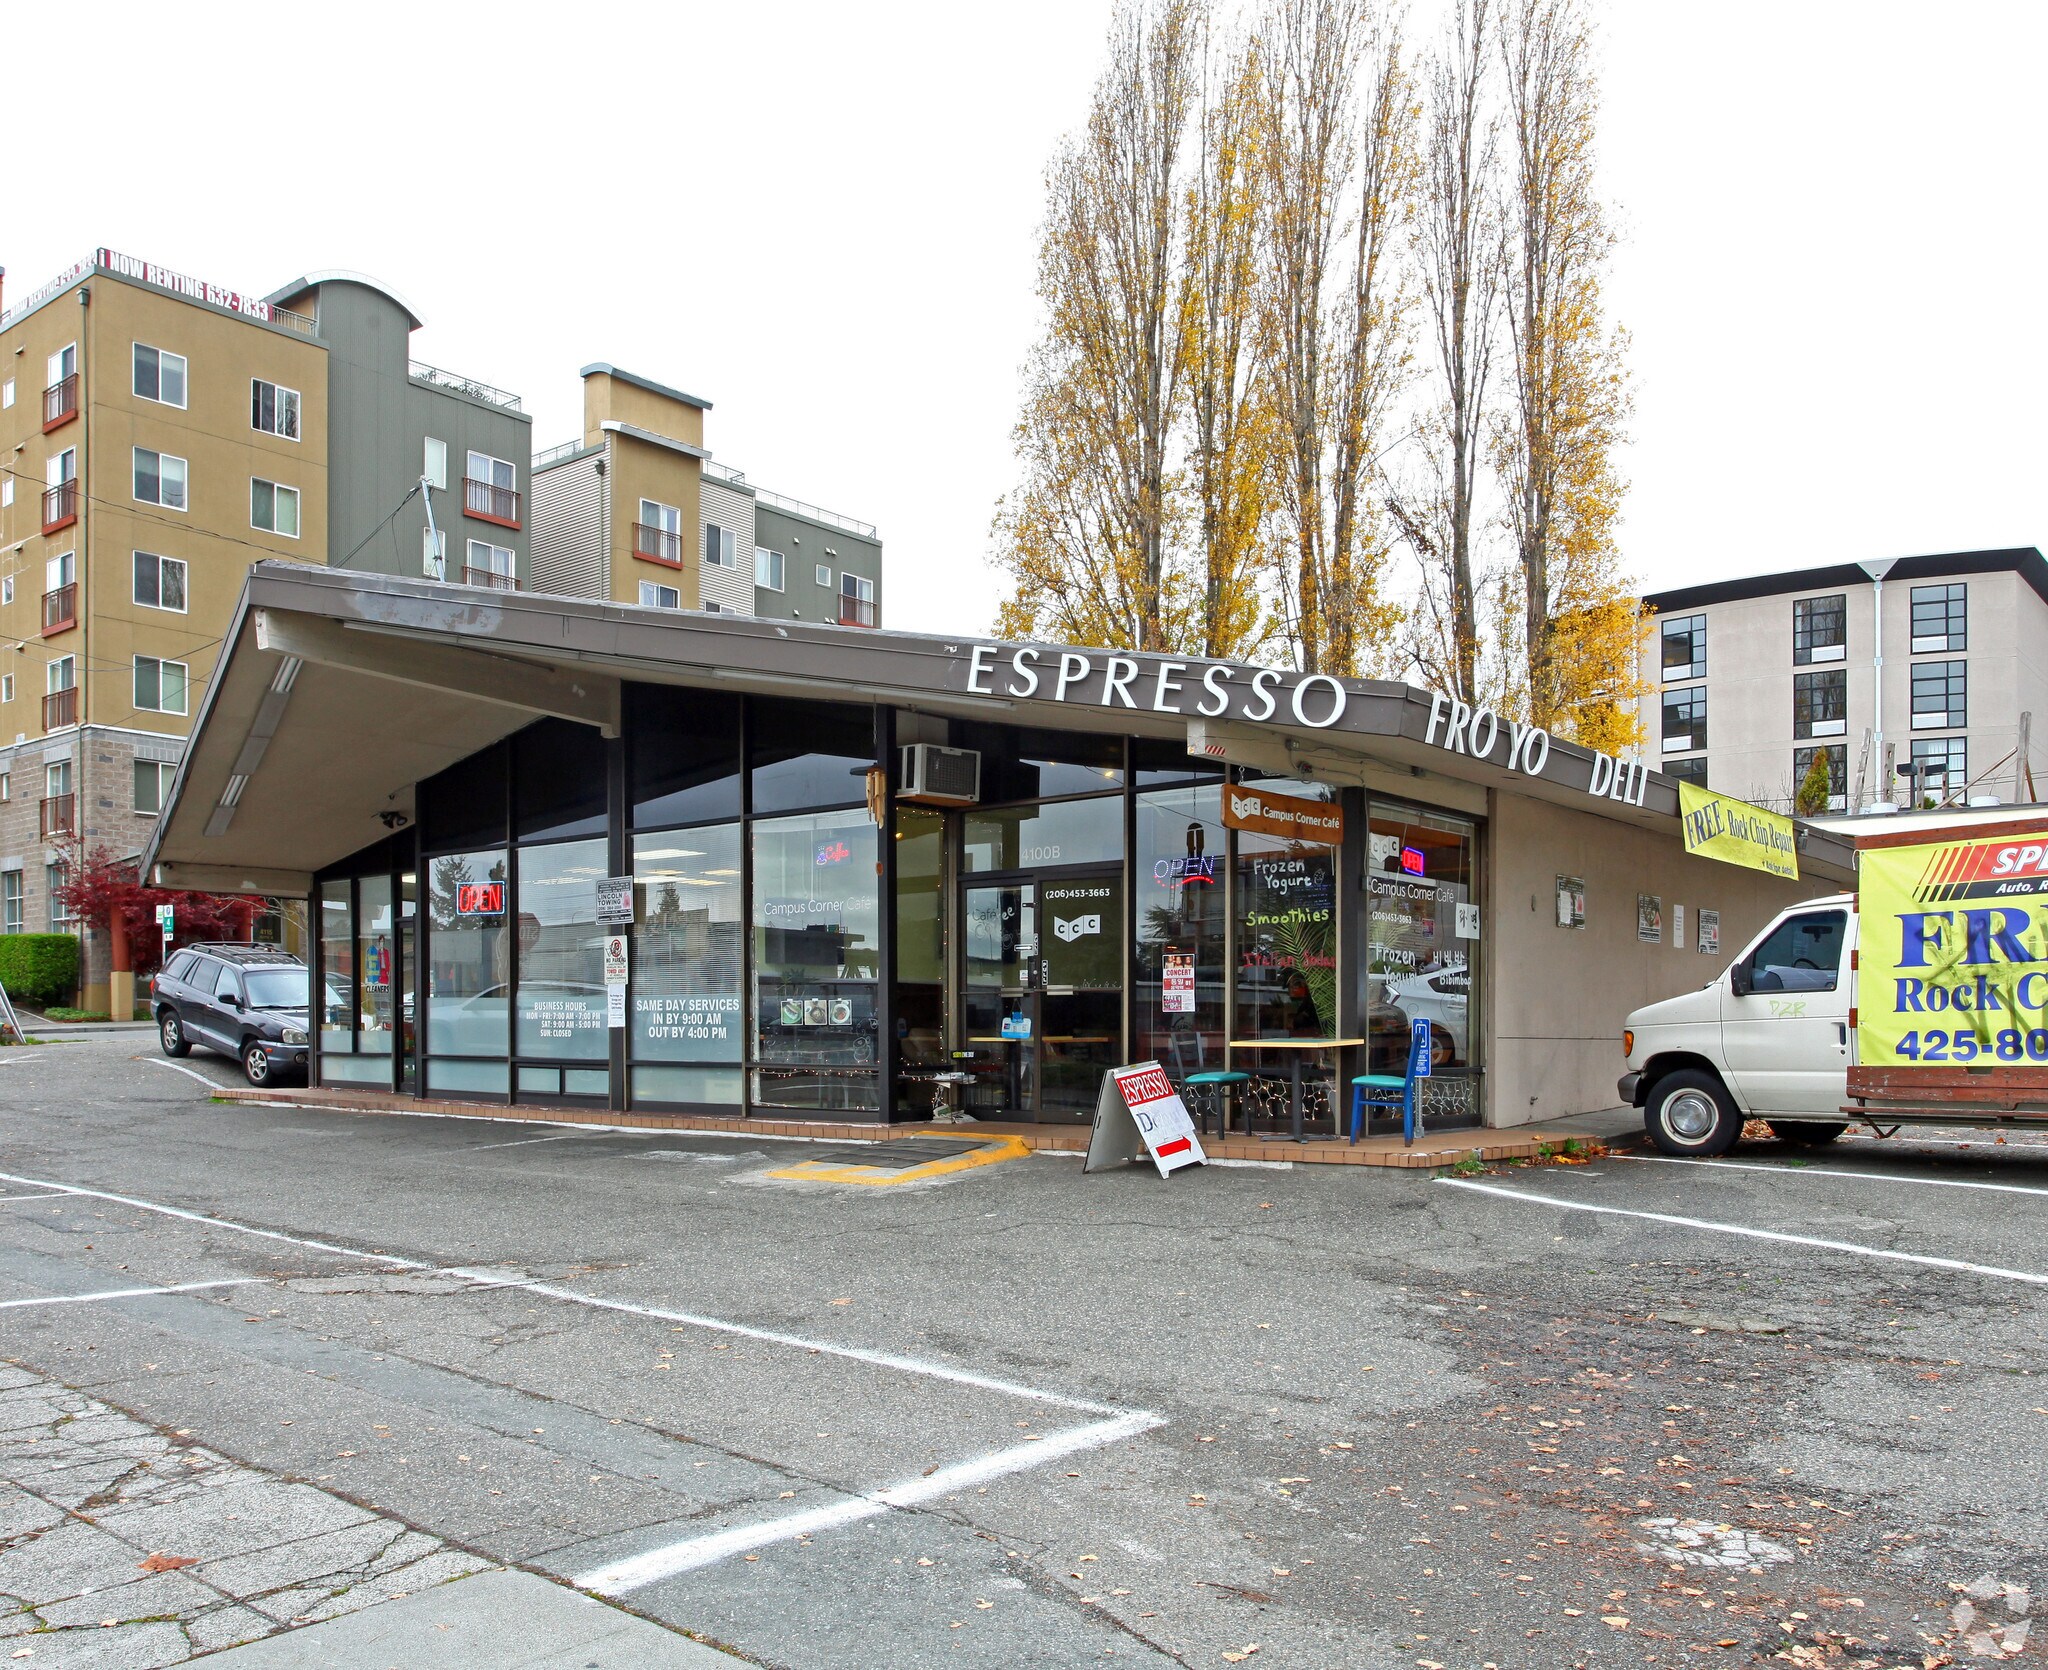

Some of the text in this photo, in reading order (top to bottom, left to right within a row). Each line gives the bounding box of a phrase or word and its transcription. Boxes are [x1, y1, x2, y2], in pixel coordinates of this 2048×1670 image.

[109, 251, 145, 280] NOW
[147, 263, 204, 301] RENTING
[206, 283, 269, 322] 632-7833
[967, 645, 1347, 728] ESPRESSO
[1425, 692, 1649, 807] FRO YO DELI
[1263, 806, 1294, 822] Campus
[1296, 812, 1321, 827] Corner
[1322, 816, 1340, 829] Café
[1684, 800, 1793, 857] FREE Rock Chip Repair
[1021, 845, 1061, 861] 4100B
[1402, 850, 1423, 873] OPEN
[1154, 855, 1215, 879] OPEN
[1253, 858, 1305, 875] Frozen
[1045, 888, 1111, 900] (206)453-3663
[1264, 874, 1312, 895] Yogurt
[1370, 878, 1455, 903] Campus Corner Café
[1995, 882, 2034, 894] Auto,
[459, 884, 502, 912] OPEN
[598, 892, 622, 900] LINCOLN
[764, 895, 872, 916] Campus Corner Café
[1246, 907, 1330, 927] Smoothies
[1893, 904, 2048, 968] FR
[1376, 943, 1416, 966] Frozen
[1166, 969, 1191, 977] CONCERT
[1439, 973, 1472, 990] Bibimbap
[366, 985, 390, 993] CLEANERS
[1893, 974, 2002, 1013] Rock
[534, 1001, 587, 1011] BUSINESS HOURS
[636, 999, 663, 1011] SAME
[666, 999, 686, 1011] DAY
[689, 998, 740, 1011] SERVICES
[526, 1012, 538, 1020] MON
[553, 1012, 565, 1020] 7:00
[566, 1012, 574, 1020] AM
[578, 1012, 591, 1020] 7:00
[592, 1012, 601, 1020] PM
[553, 1020, 565, 1028] 9:00
[566, 1020, 574, 1028] AM
[592, 1020, 601, 1028] PM
[653, 1013, 722, 1025] IN BY 9:00 AM
[553, 1029, 572, 1037] CLOSED
[648, 1026, 727, 1039] OUT BY 4:00 PM
[1895, 1028, 2048, 1062] 425-80
[1120, 1071, 1169, 1104] ESPRESSO
